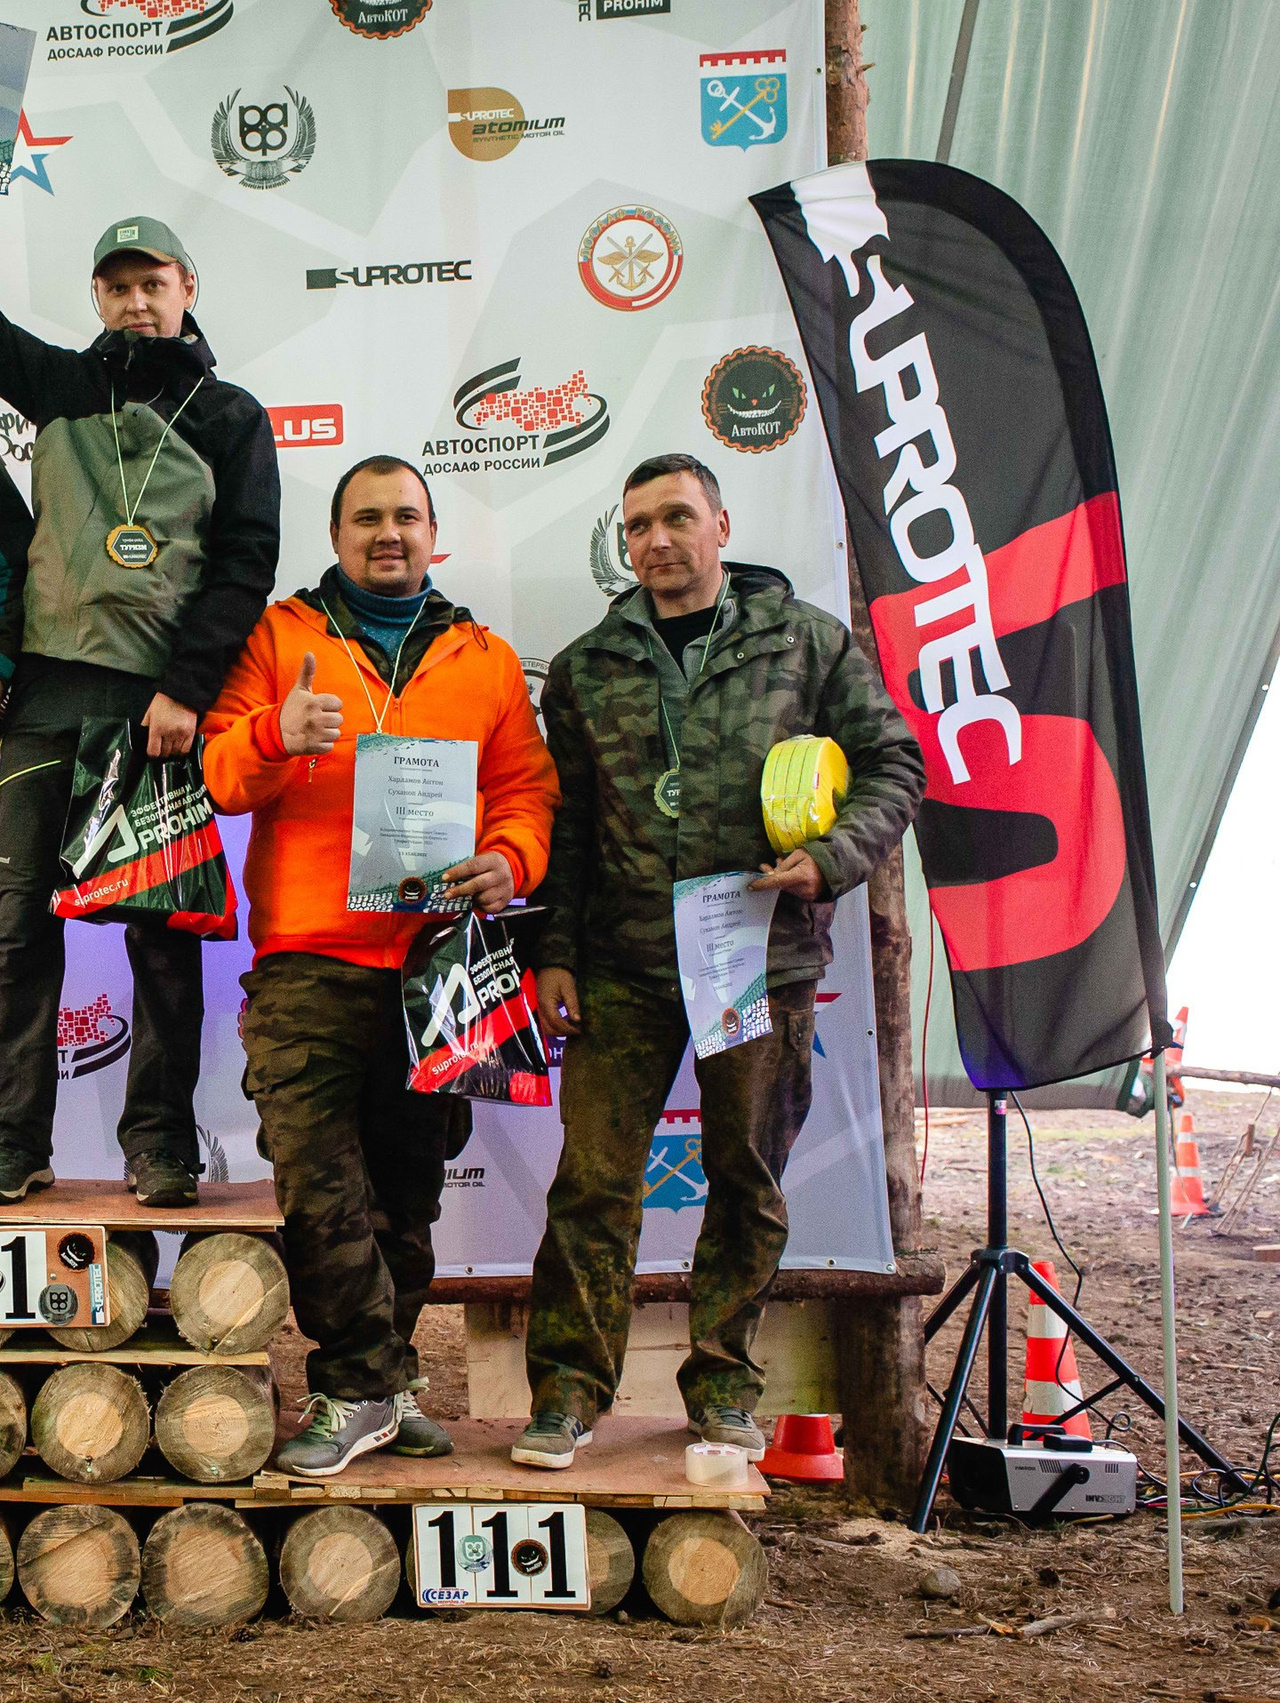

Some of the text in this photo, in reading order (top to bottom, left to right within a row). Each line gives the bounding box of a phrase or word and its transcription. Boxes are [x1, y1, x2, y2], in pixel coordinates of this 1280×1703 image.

[46, 22, 163, 41] АВТОСПОРТ
[48, 44, 163, 61] ДОСААФ РОССИИ
[460, 108, 514, 120] SUPROTEC
[472, 117, 565, 135] atomium
[337, 260, 472, 287] SUPROTEC
[731, 421, 781, 437] АвтоКОТ
[422, 435, 540, 457] АВТОСПОРТ
[423, 456, 541, 477] ДОСААФ РОССИИ
[821, 250, 1022, 785] SUPROTEC
[394, 756, 440, 768] ГРАМОТА
[408, 809, 434, 817] место
[138, 797, 213, 850] PROHIM
[702, 890, 741, 903] ГРАМОТА
[1, 1235, 36, 1320] 1
[428, 1510, 576, 1598] 111
[431, 1590, 469, 1600] СЕЗАР
